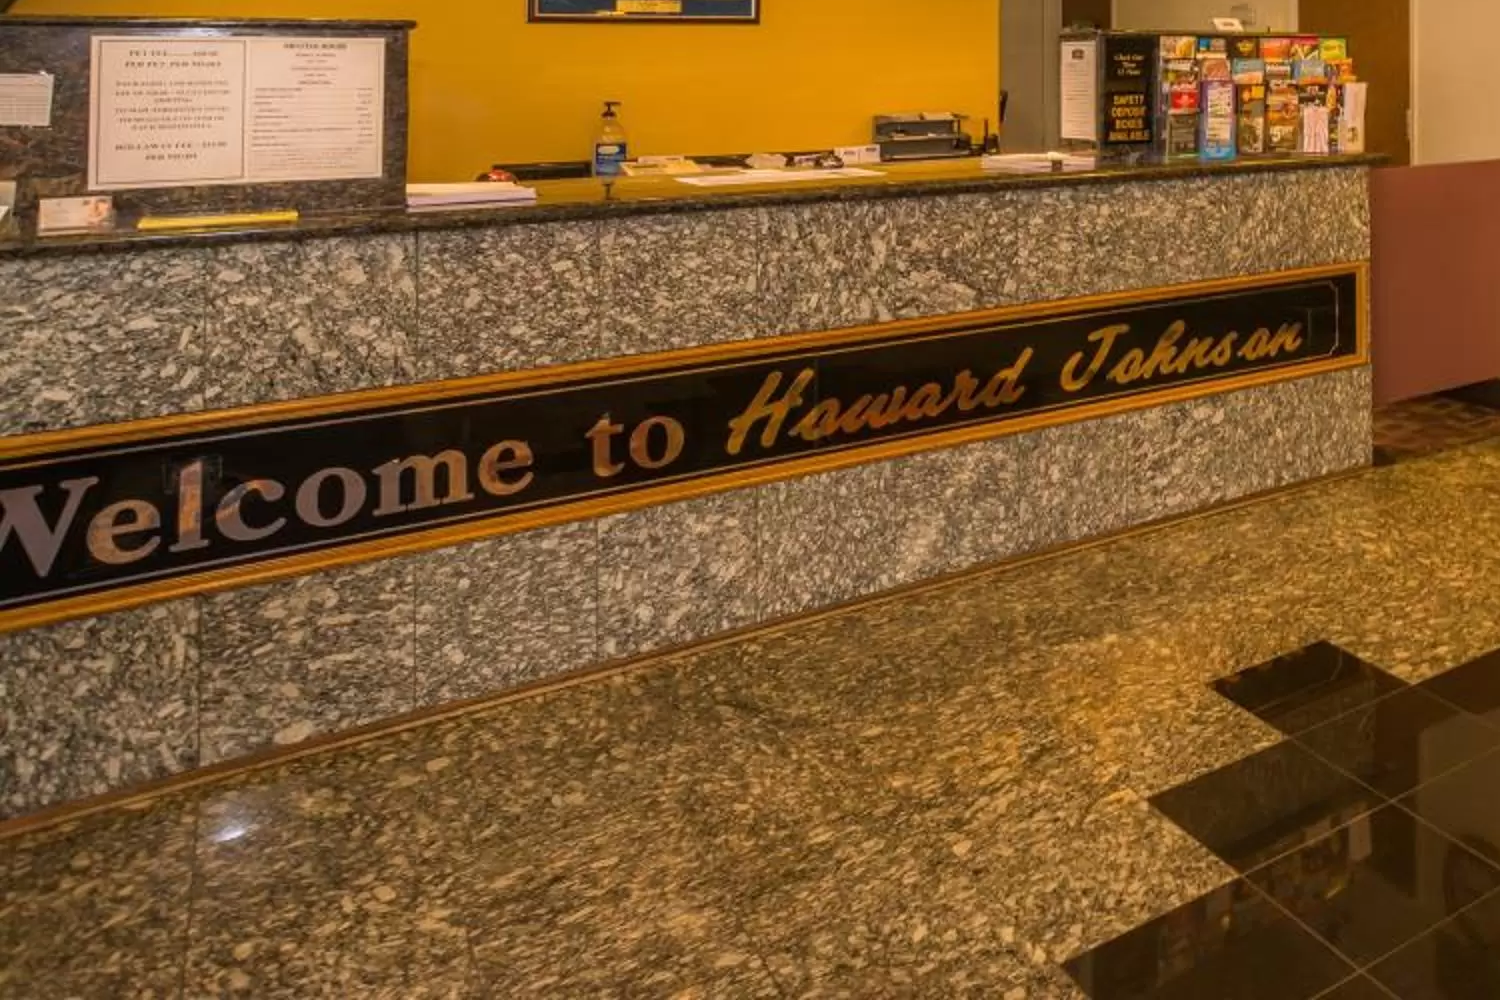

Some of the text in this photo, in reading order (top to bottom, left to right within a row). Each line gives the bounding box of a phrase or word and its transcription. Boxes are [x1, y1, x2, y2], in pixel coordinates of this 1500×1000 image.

[1113, 95, 1145, 105] SAFETY
[0, 318, 1303, 579] Welcome to Howard Johnson
